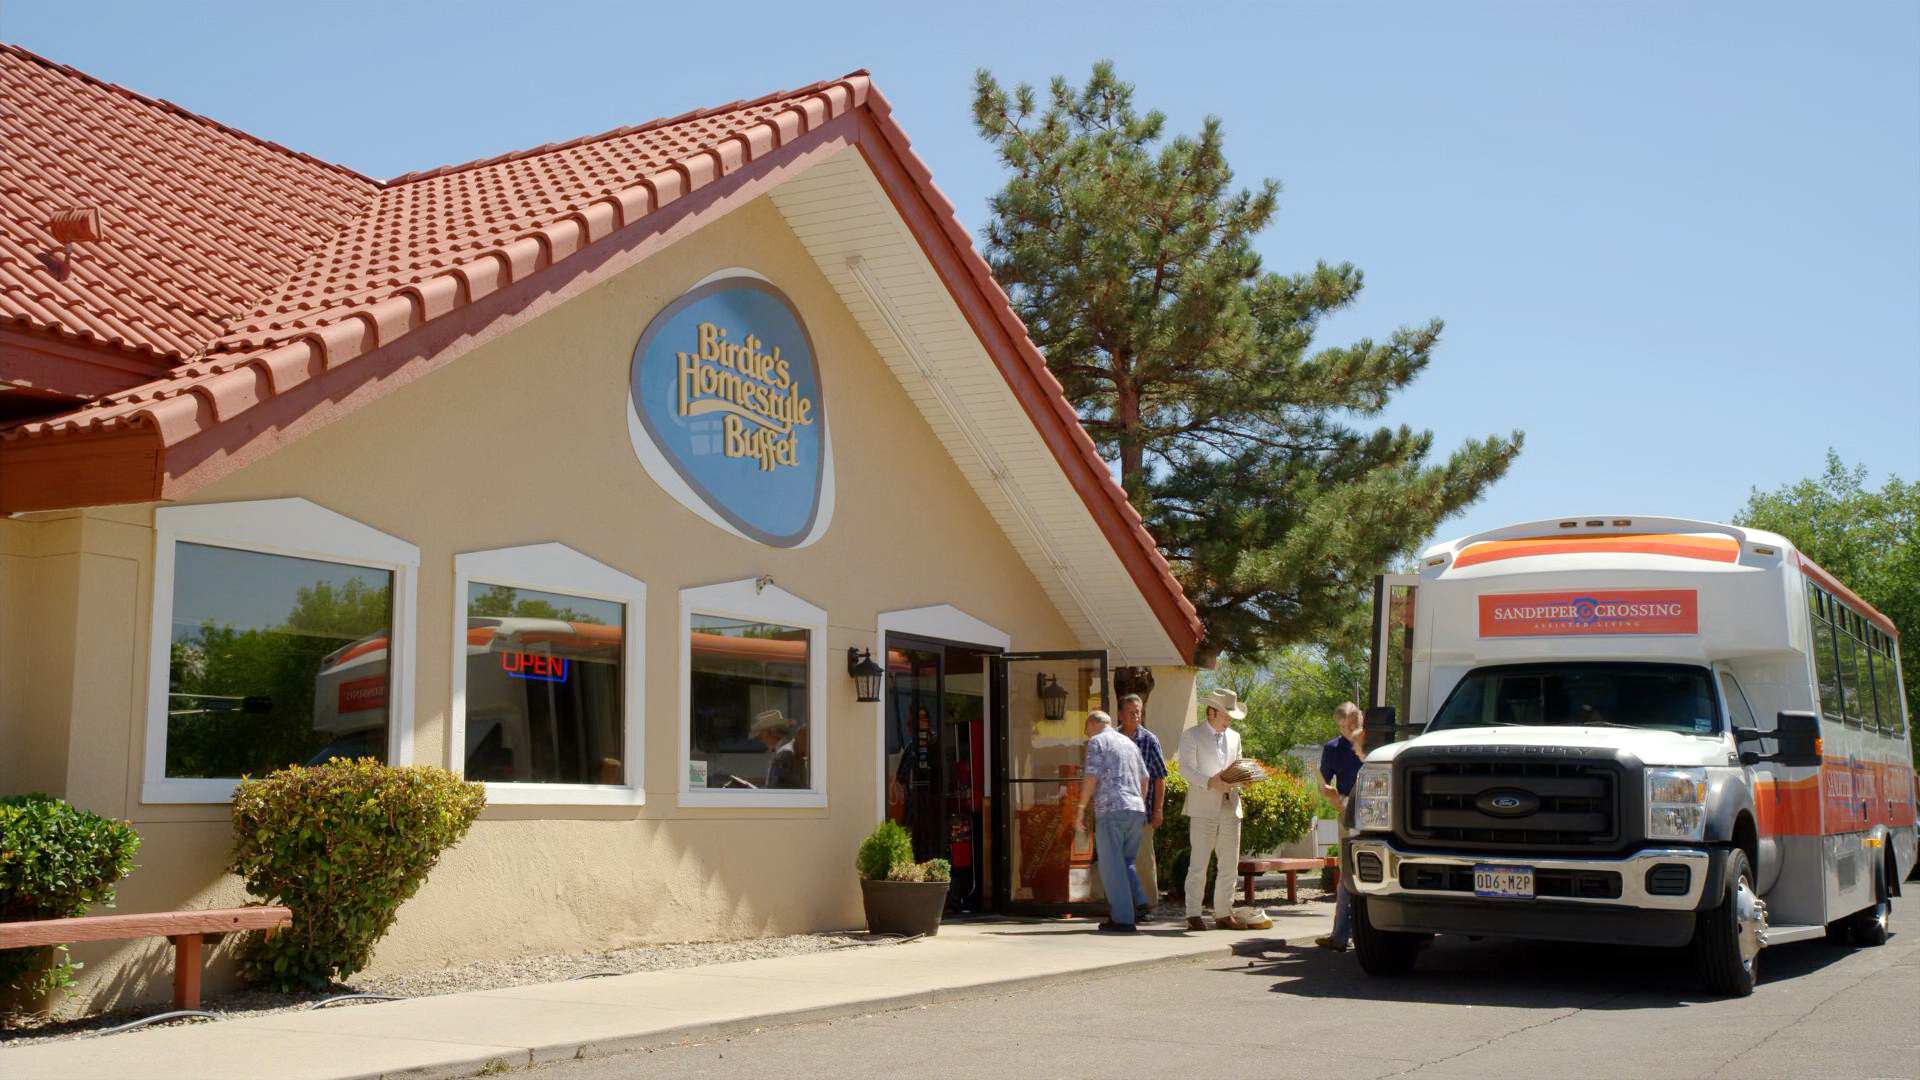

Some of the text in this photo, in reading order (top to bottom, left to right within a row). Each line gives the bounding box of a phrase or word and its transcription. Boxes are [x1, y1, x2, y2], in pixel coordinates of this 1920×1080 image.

[698, 322, 790, 390] Birdie's
[676, 351, 814, 434] Homestyle
[724, 414, 801, 472] Buffet
[1494, 603, 1682, 620] SANDPIPER CROSSING
[1534, 620, 1641, 629] ASSISTED LIVING
[501, 651, 563, 677] OPEN
